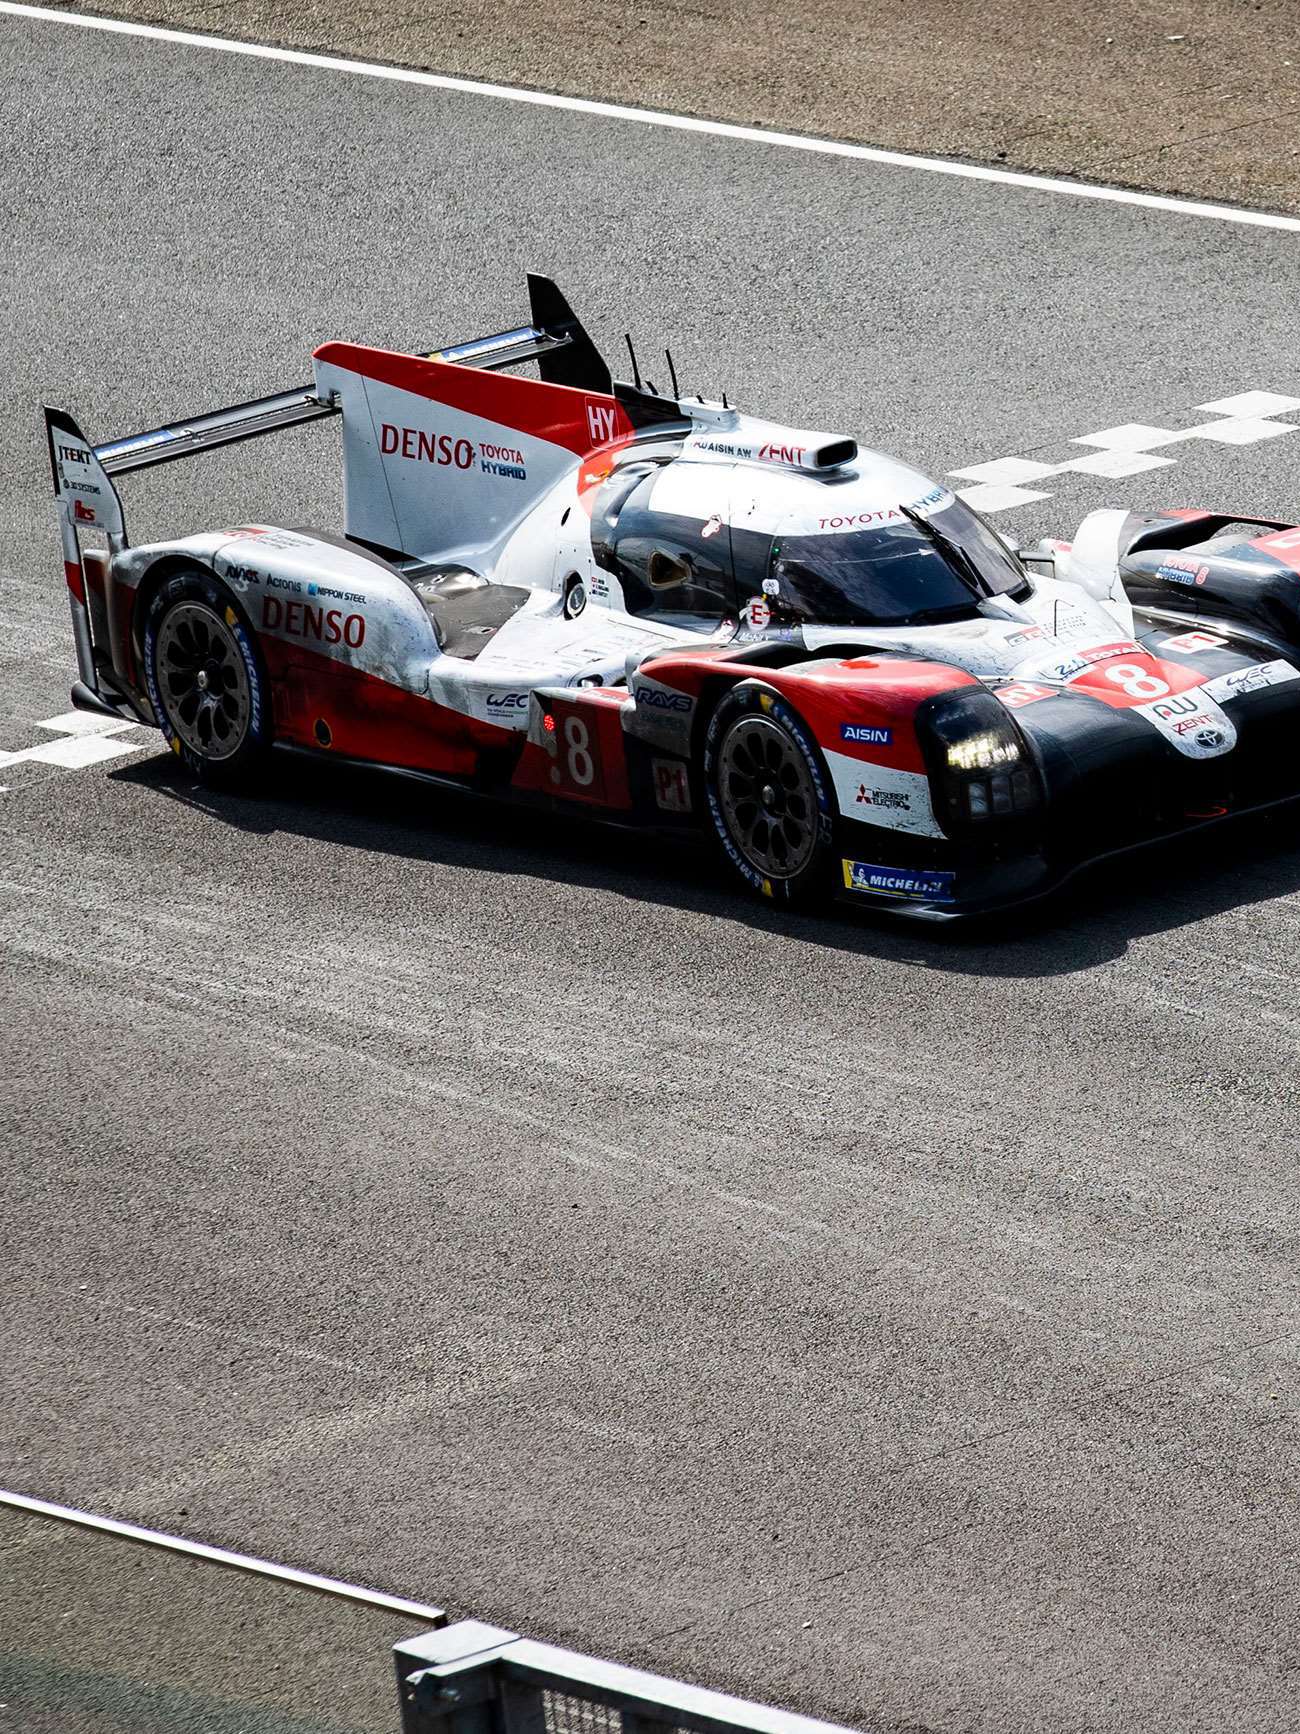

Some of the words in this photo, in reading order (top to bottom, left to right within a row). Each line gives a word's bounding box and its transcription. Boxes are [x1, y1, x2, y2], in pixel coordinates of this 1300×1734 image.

[588, 405, 615, 442] HY
[58, 445, 91, 465] JTEKT
[381, 424, 473, 470] DENSO
[478, 443, 525, 465] TOYOTA
[707, 442, 734, 456] AISIN
[737, 447, 752, 458] AW
[481, 459, 527, 481] HYBRID
[817, 508, 901, 530] TOYOTA
[267, 573, 302, 593] Acronis
[1196, 566, 1210, 585] 8
[317, 586, 343, 600] NIPPON
[344, 591, 367, 605] STEEL
[262, 595, 366, 649] DENSO
[1104, 663, 1170, 699] 8
[1226, 664, 1273, 687] WEC
[486, 693, 529, 709] WEC
[636, 686, 693, 712] RAYS
[844, 726, 888, 743] AISIN
[1171, 713, 1213, 737] ZENT
[564, 715, 595, 786] 8
[780, 714, 825, 802] MICHELIN
[657, 766, 686, 804] P1
[872, 789, 911, 801] MITSUBISHI
